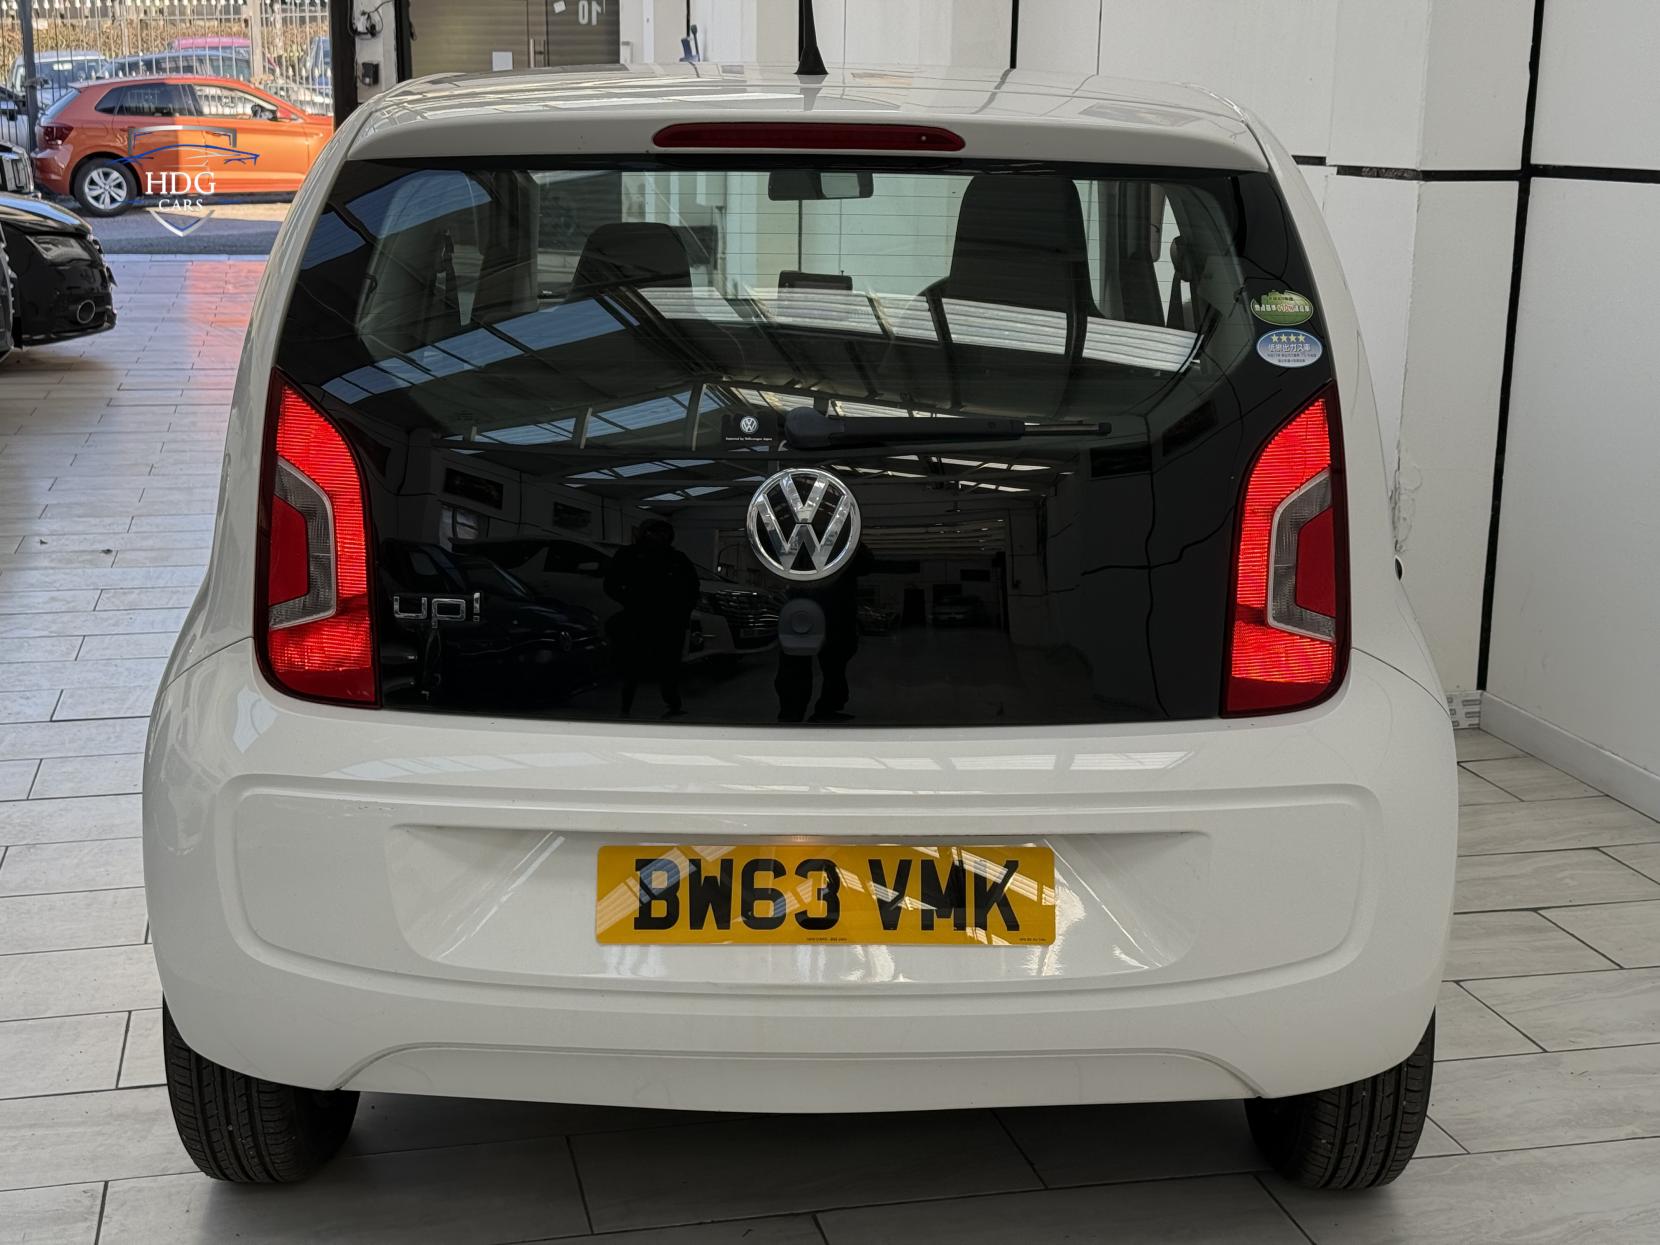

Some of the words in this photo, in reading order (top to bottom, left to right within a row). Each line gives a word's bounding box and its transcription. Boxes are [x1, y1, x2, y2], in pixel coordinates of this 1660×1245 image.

[750, 470, 858, 578] VW
[393, 592, 481, 629] up!
[633, 858, 841, 930] BW63
[867, 858, 1020, 932] VMK
